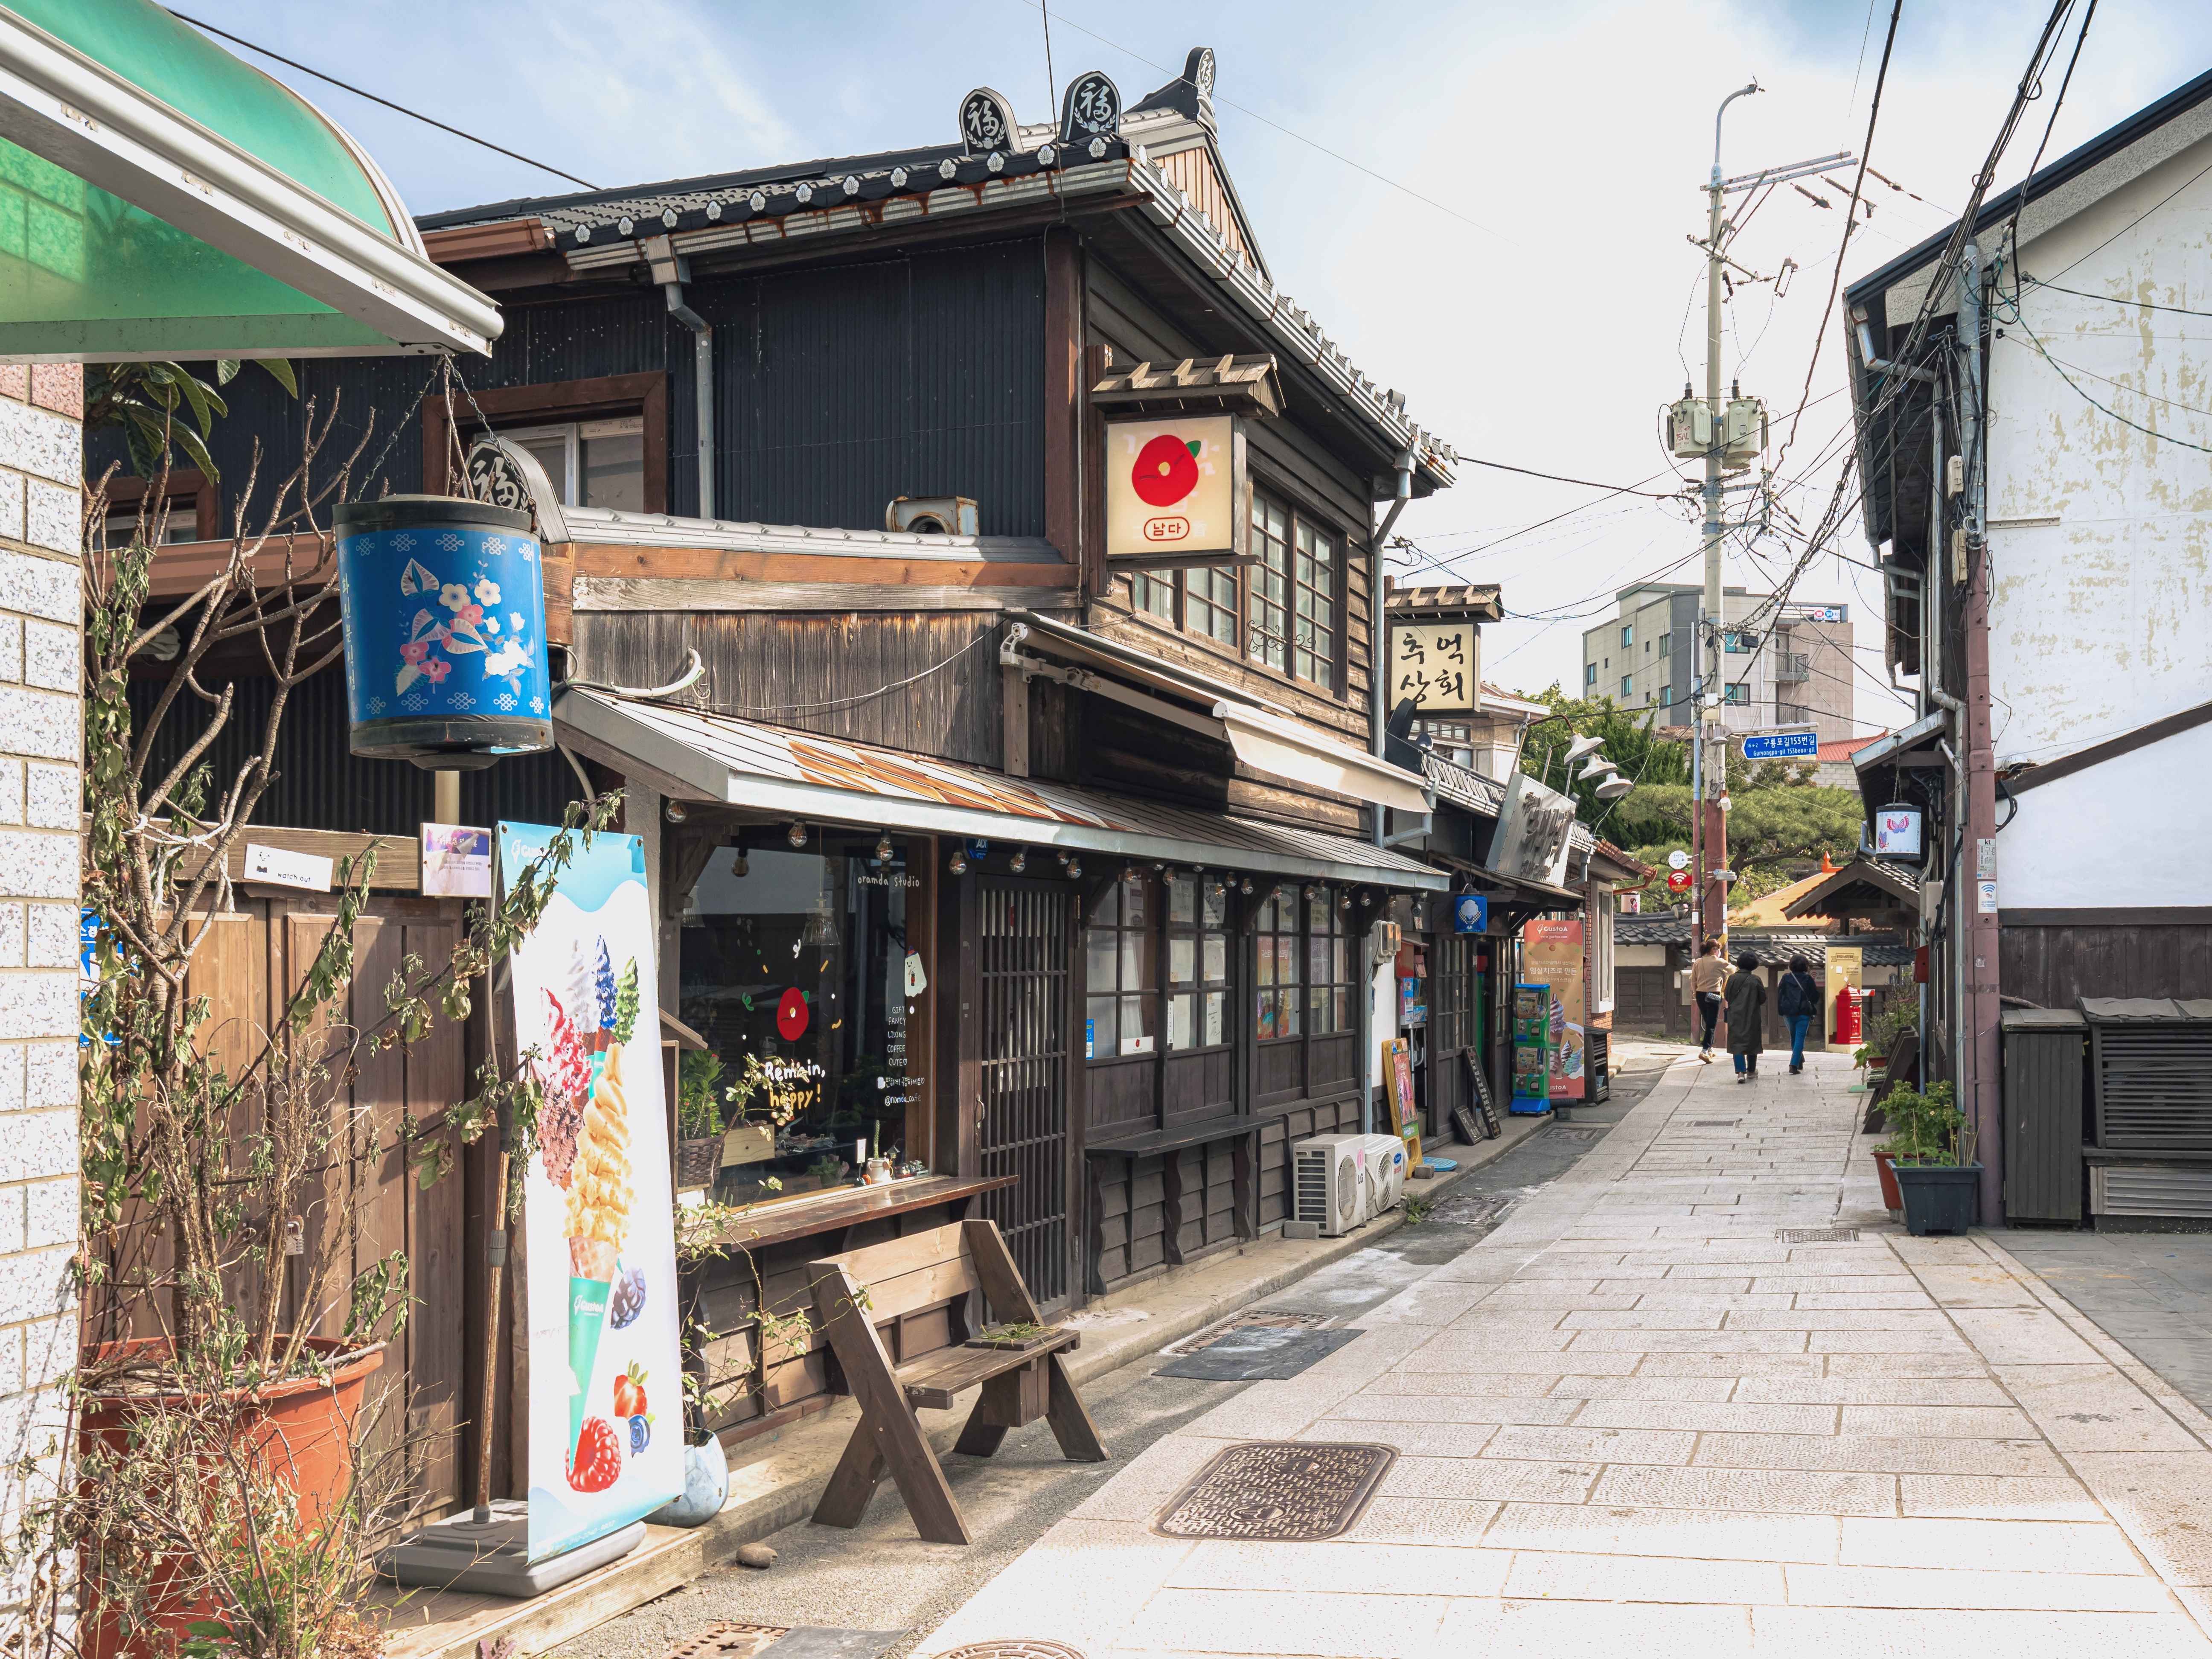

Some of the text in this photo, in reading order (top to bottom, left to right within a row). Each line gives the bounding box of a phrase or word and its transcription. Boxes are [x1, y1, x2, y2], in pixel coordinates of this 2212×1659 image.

[1153, 522, 1182, 536] 남다
[1400, 632, 1464, 665] 추억
[1400, 669, 1464, 703] 상회
[1763, 735, 1815, 748] 구룡포길153번길
[1753, 748, 1786, 757] Guryongpo-gil
[858, 873, 889, 885] oramda
[1529, 966, 1563, 975] 임실치즈로
[892, 1006, 905, 1014] GIFT
[888, 1016, 906, 1025] FANCY
[887, 1045, 905, 1053] COFFEE
[1358, 1173, 1363, 1185] LG
